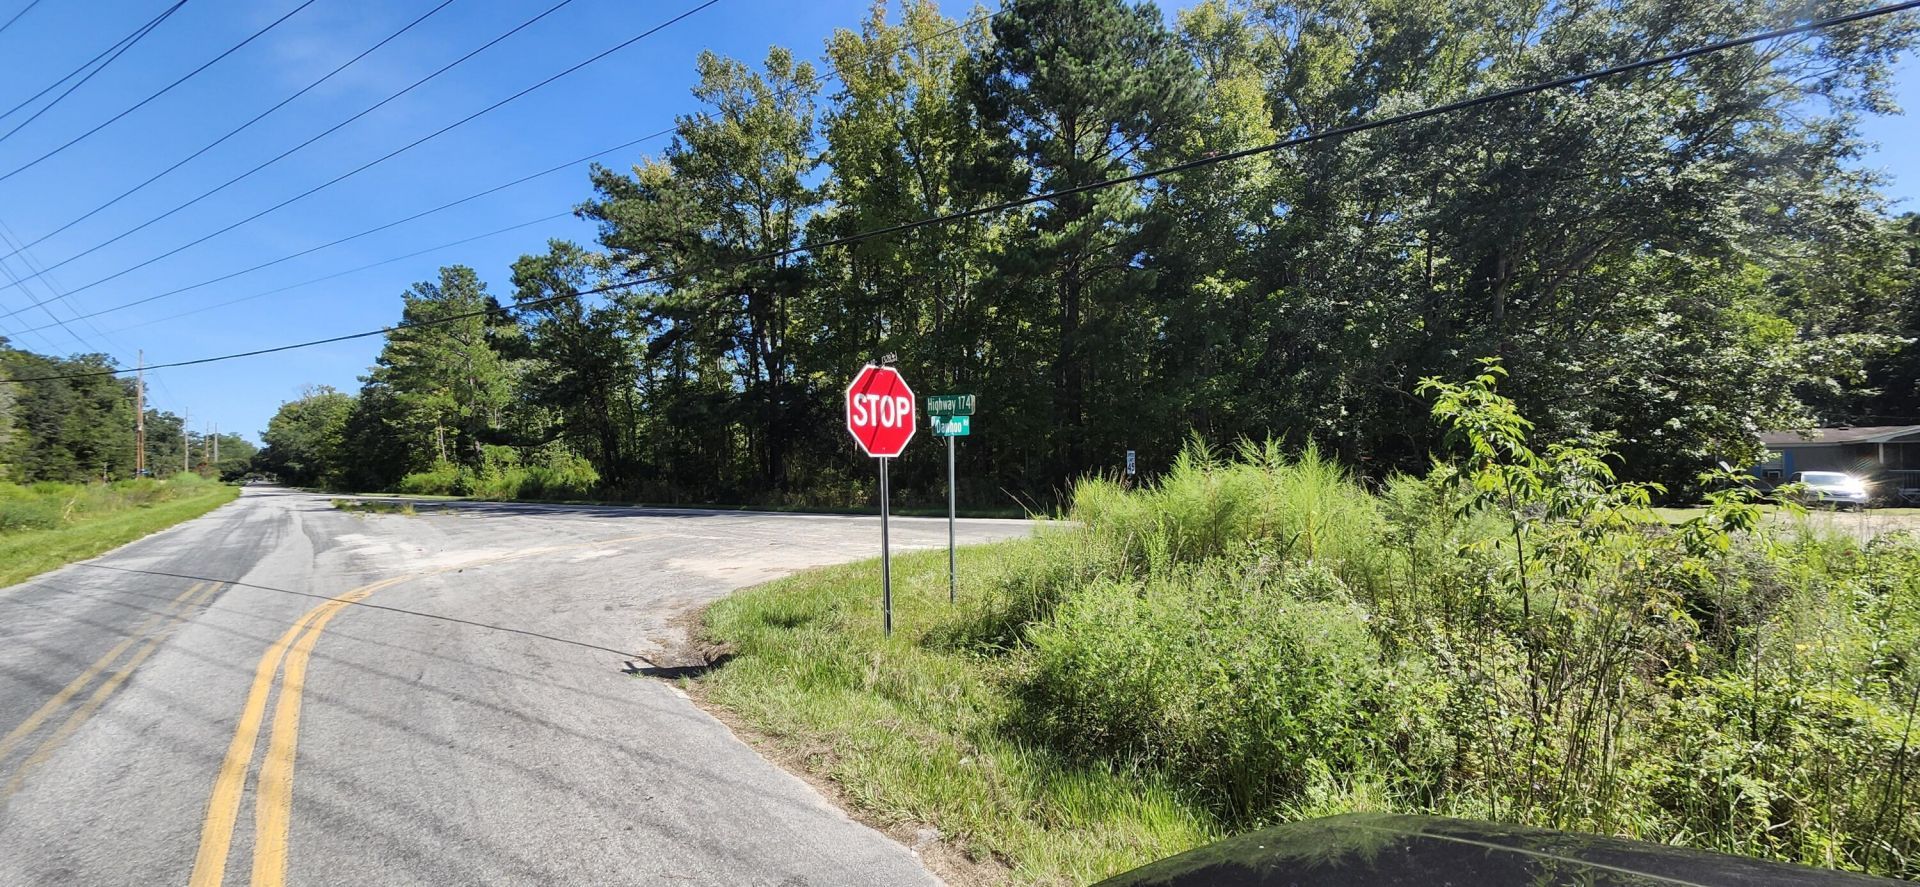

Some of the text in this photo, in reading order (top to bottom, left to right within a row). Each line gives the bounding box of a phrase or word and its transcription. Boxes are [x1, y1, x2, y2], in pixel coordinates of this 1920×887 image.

[853, 394, 910, 428] STOP
[927, 395, 971, 415] Highway 174
